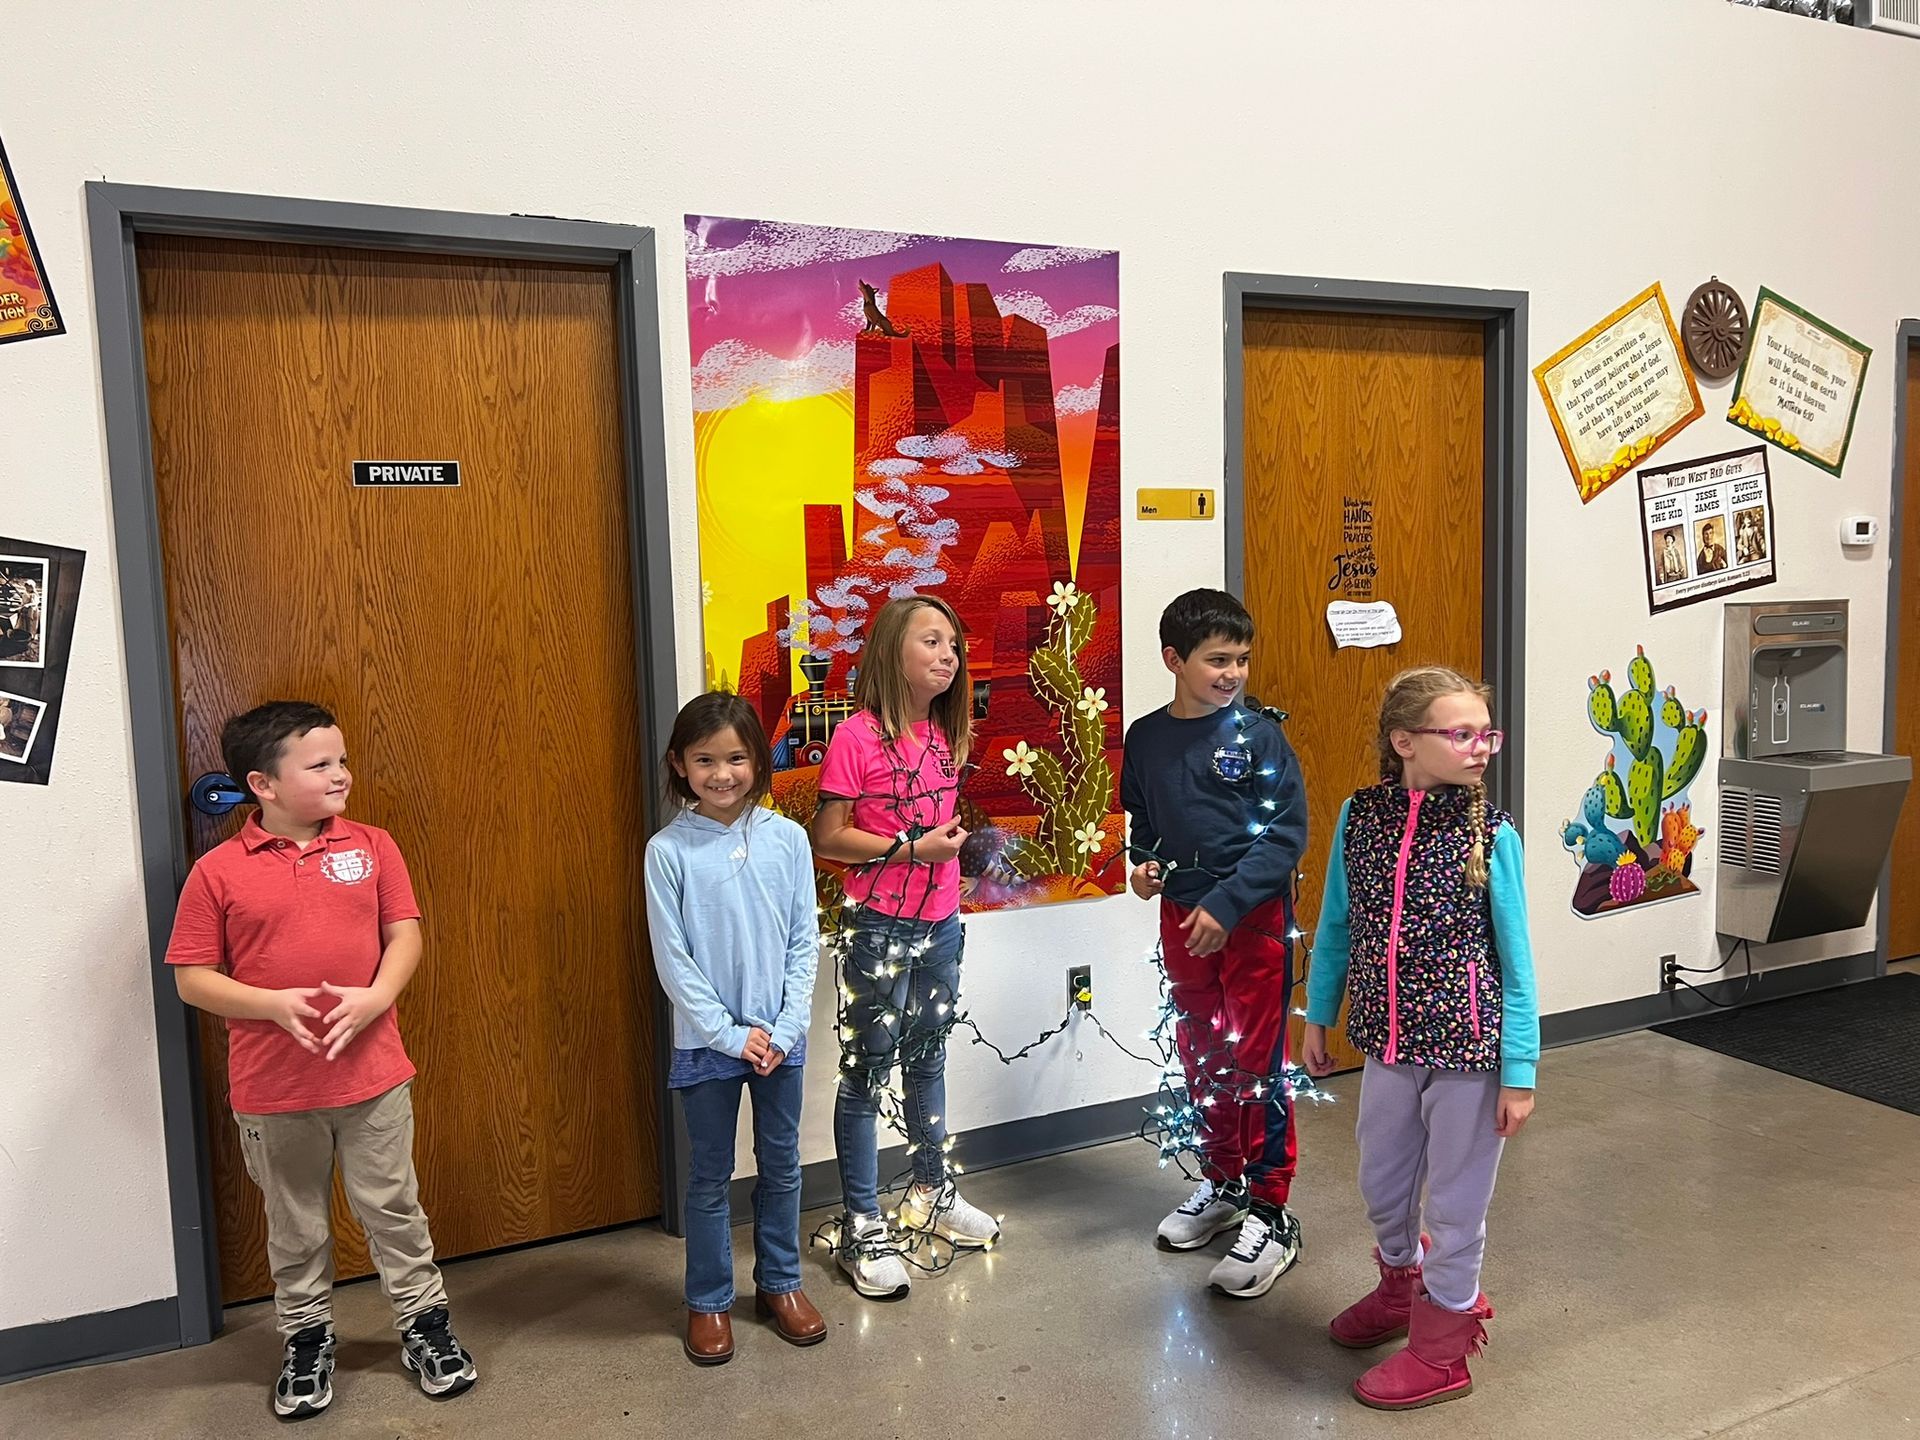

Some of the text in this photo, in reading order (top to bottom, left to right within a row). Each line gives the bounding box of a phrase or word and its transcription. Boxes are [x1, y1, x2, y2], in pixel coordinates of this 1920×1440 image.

[1572, 376, 1584, 388] But
[1584, 365, 1601, 379] these
[1603, 355, 1613, 367] are
[1614, 340, 1637, 358] written
[1639, 332, 1646, 340] so
[1767, 335, 1782, 351] Your
[1783, 345, 1810, 368] kingdom
[1831, 375, 1846, 387] your
[1566, 338, 1662, 410] that you may believe that Jesus
[1768, 357, 1782, 369] will
[1783, 363, 1791, 374] be
[1810, 381, 1818, 390] on
[1820, 386, 1837, 400] earth
[1577, 411, 1583, 420] is
[1584, 404, 1595, 415] the
[1617, 379, 1628, 390] the
[1628, 370, 1639, 382] Son
[1640, 362, 1647, 373] of
[1769, 376, 1777, 386] as
[1779, 379, 1785, 389] it
[1787, 383, 1793, 394] is
[1795, 388, 1802, 399] in
[1579, 366, 1669, 436] and that by believing you may
[1597, 425, 1612, 439] have
[1613, 415, 1623, 427] life
[1624, 410, 1633, 418] in
[1633, 402, 1643, 413] his
[1636, 412, 1651, 429] 20:31
[368, 466, 444, 481] PRIVATE
[1667, 464, 1743, 488] WILD WEST BAD GUYS
[1695, 489, 1717, 501] JESSE
[1734, 480, 1758, 492] BUTCH
[1655, 498, 1676, 510] BILLY
[1695, 500, 1720, 513] JAMES
[1732, 491, 1762, 504] CASSIDY
[1344, 509, 1373, 523] HANDS
[1651, 509, 1682, 523] THE KID
[1344, 531, 1373, 543] PRAYERS
[1328, 554, 1379, 590] Jesus
